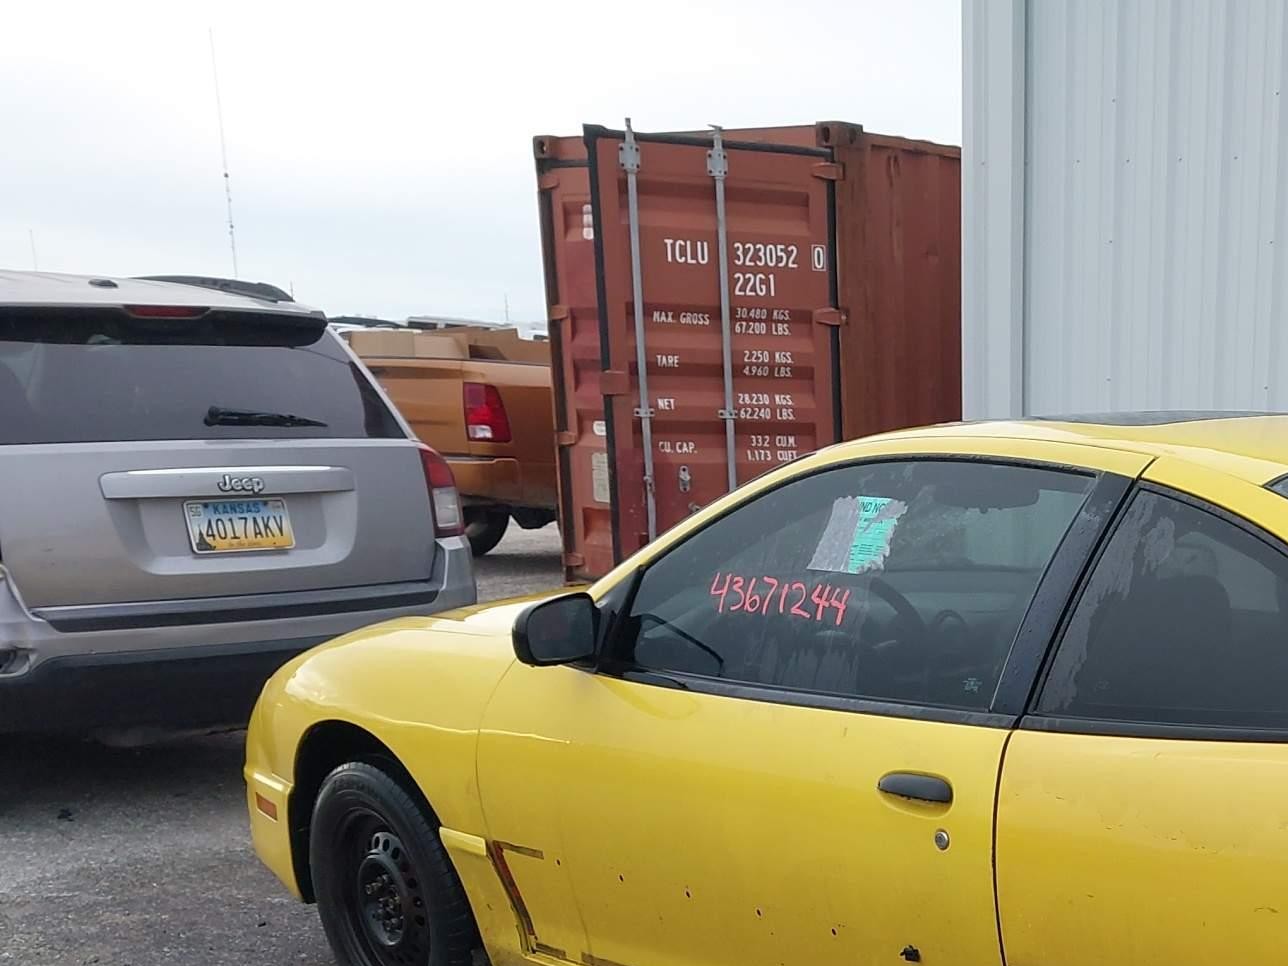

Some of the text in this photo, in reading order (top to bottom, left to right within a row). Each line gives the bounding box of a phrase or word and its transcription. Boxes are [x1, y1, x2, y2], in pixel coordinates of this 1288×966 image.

[664, 239, 825, 269] TCLU 323052 0
[734, 272, 776, 296] 22G1
[680, 312, 710, 325] GROSS
[736, 307, 767, 320] 30.480
[772, 309, 791, 320] KGS.
[735, 321, 792, 335] 67.200 LBS.
[656, 350, 795, 367] TARE 2.250 KGS.
[743, 365, 793, 378] 4.960 LBS.
[657, 393, 794, 410] NET 28.230 KGS.
[740, 407, 796, 420] 62.240 LBS.
[658, 441, 674, 453] CU.
[675, 441, 698, 454] CAP.
[747, 449, 771, 461] 1.173
[217, 474, 265, 493] Jeep
[213, 502, 262, 514] KANSAS
[206, 515, 284, 541] 4017AKV
[710, 572, 850, 626] 43671244
